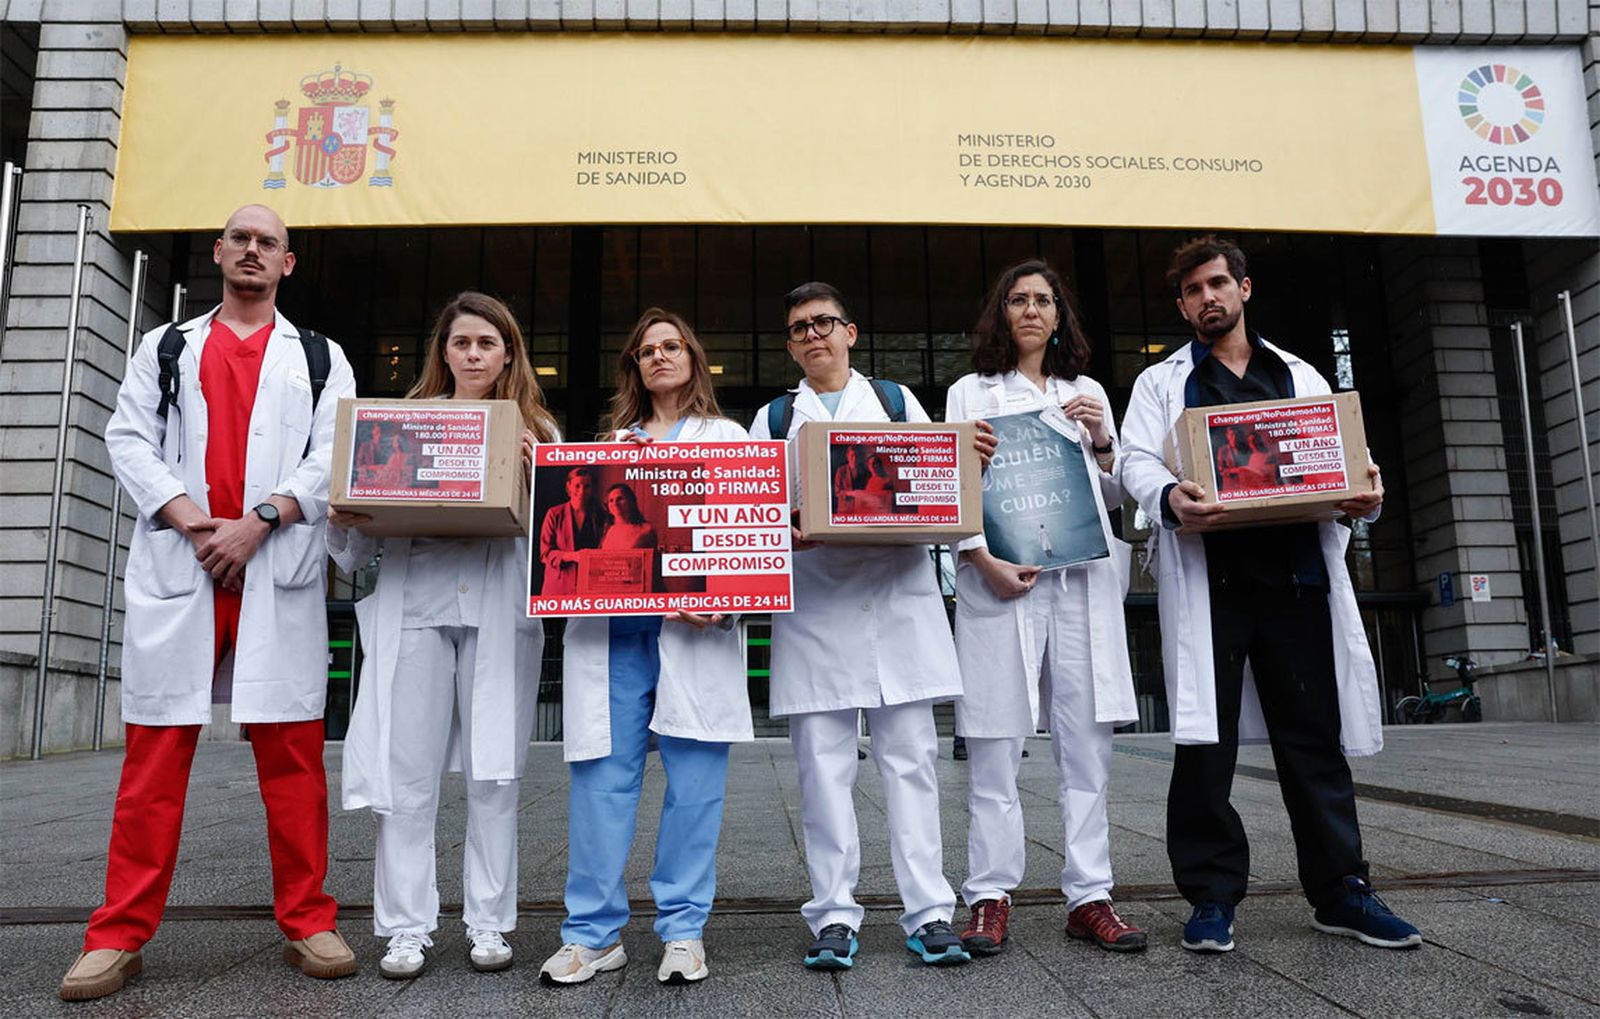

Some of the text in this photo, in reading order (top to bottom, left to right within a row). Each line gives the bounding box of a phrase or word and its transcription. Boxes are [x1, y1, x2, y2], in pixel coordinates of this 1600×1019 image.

[957, 133, 1056, 148] MINISTERIO
[577, 151, 678, 165] MINISTERIO
[959, 154, 1264, 173] DE DERECHOS SOCIALES, CONSUMO
[1458, 155, 1561, 173] AGENDA
[577, 171, 687, 185] DE SANIDAD
[959, 174, 1092, 189] Y AGENDA 2030
[1461, 176, 1564, 207] 2030
[1213, 406, 1331, 424] change.org/NoPodemosMas
[402, 423, 435, 431] Ministra
[436, 423, 446, 431] de
[1254, 420, 1286, 431] Ministra
[1302, 424, 1334, 434] FIRMAS
[448, 432, 481, 440] FIRMAS
[835, 434, 953, 444] change.org/NoPodemosMas
[998, 430, 1010, 444] A
[428, 445, 435, 454] Y
[437, 445, 454, 455] UN
[875, 446, 954, 454] Ministra de Sanidad:
[1284, 442, 1291, 450] Y
[1294, 440, 1310, 450] UN
[546, 444, 779, 464] change.org/NoPodemosMas
[889, 455, 954, 463] 180.000 FIRMAS
[990, 442, 1062, 469] QUIÉN
[1297, 451, 1325, 460] DESDE
[438, 459, 480, 467] DESDE TU
[1282, 462, 1342, 475] COMPROMISO
[420, 470, 480, 479] COMPROMISO
[625, 466, 781, 481] Ministra de Sanidad:
[903, 469, 911, 477] Y
[912, 469, 929, 478] UN
[651, 481, 781, 496] 180.000 FIRMAS
[915, 482, 955, 491] DESDE TU
[995, 473, 1026, 492] ME
[898, 494, 956, 503] COMPROMISO
[1000, 488, 1072, 514] CUIDA?
[678, 503, 782, 524] Y UN AÑO
[863, 515, 899, 523] GUARDIAS
[702, 534, 782, 548] DESDE TU
[668, 556, 786, 572] COMPROMISO
[532, 594, 789, 614] ¡NO MÁS GUARDIAS MÉDICAS DE 24 H!
